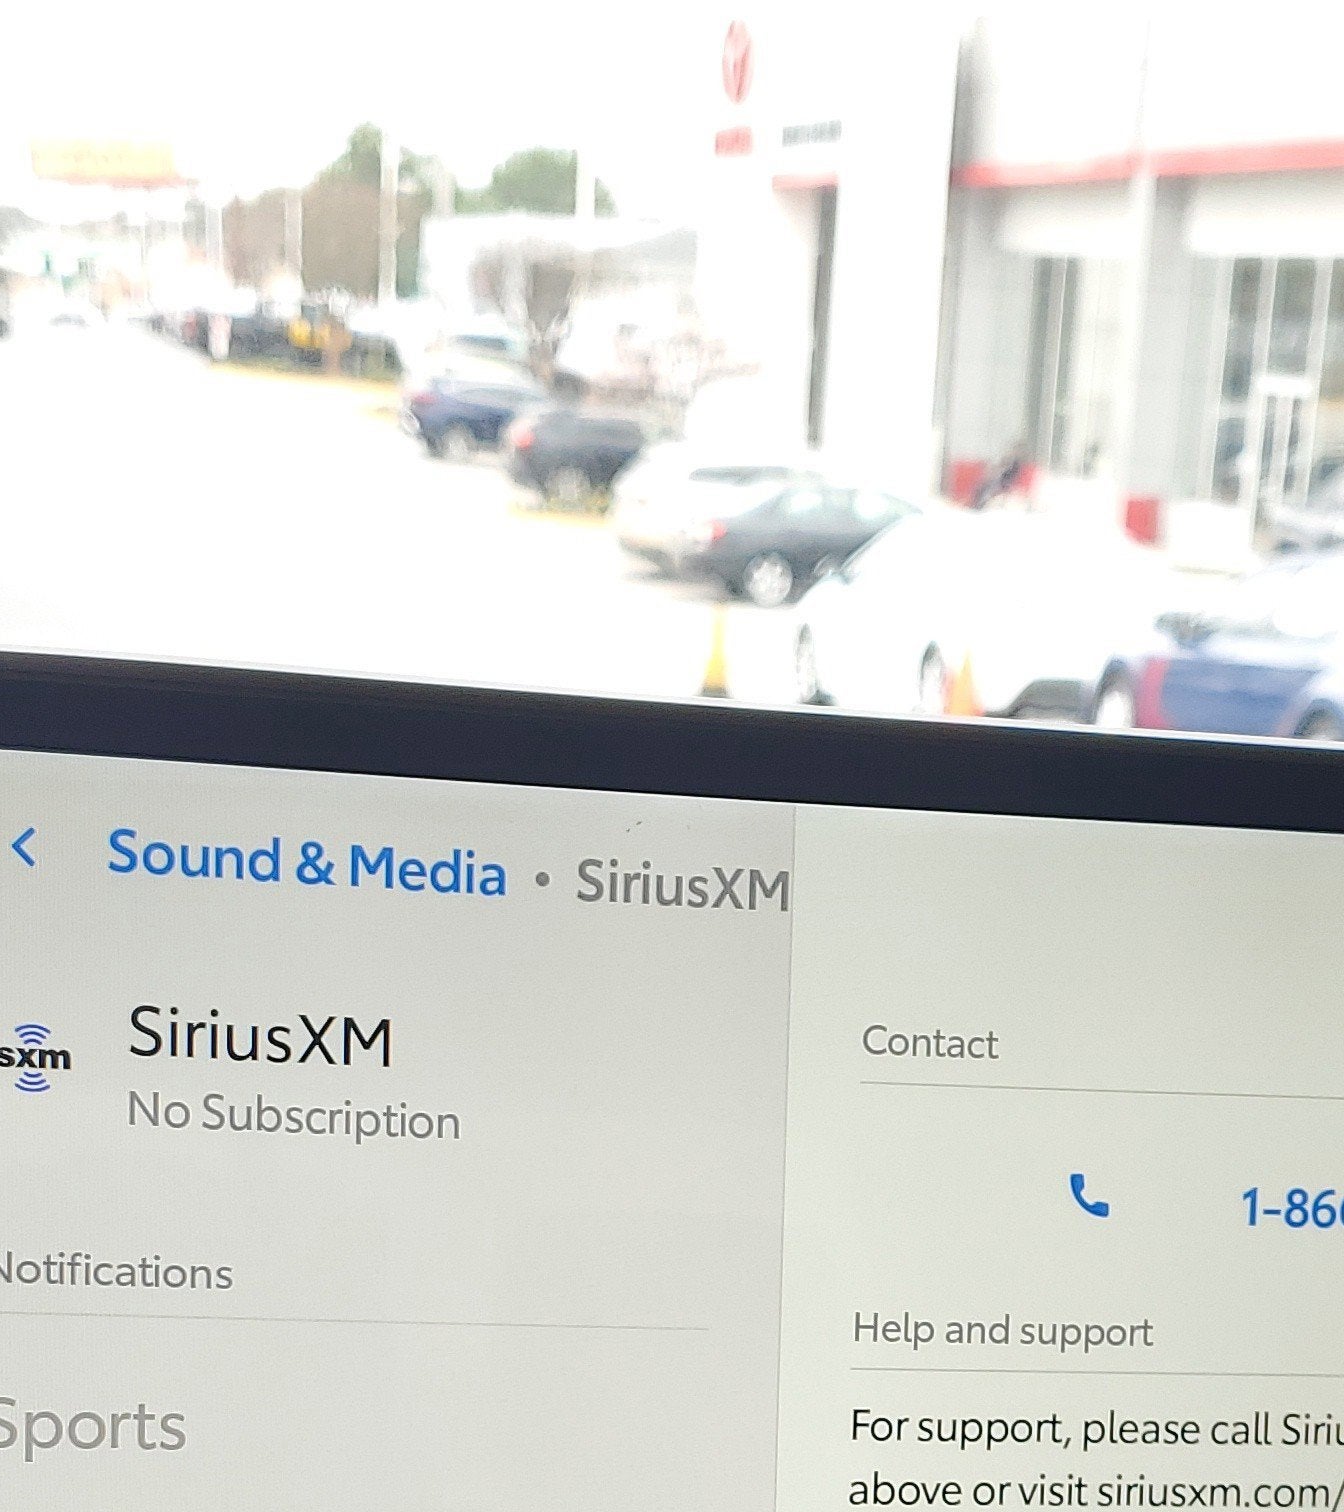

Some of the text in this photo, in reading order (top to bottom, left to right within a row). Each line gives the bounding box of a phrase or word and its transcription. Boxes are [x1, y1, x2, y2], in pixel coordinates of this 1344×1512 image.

[108, 828, 790, 912] Sound & Media SiriusXM
[129, 1004, 391, 1068] SiriusXM
[862, 1024, 1000, 1060] Contact
[128, 1089, 460, 1146] No Subscription
[854, 1311, 1154, 1354] Help and support
[852, 1408, 910, 1442] For
[917, 1413, 1071, 1451] support,
[1083, 1409, 1201, 1452] please
[1210, 1411, 1272, 1446] call
[848, 1470, 962, 1506] above
[972, 1481, 1012, 1506] or
[1018, 1473, 1088, 1507] visit
